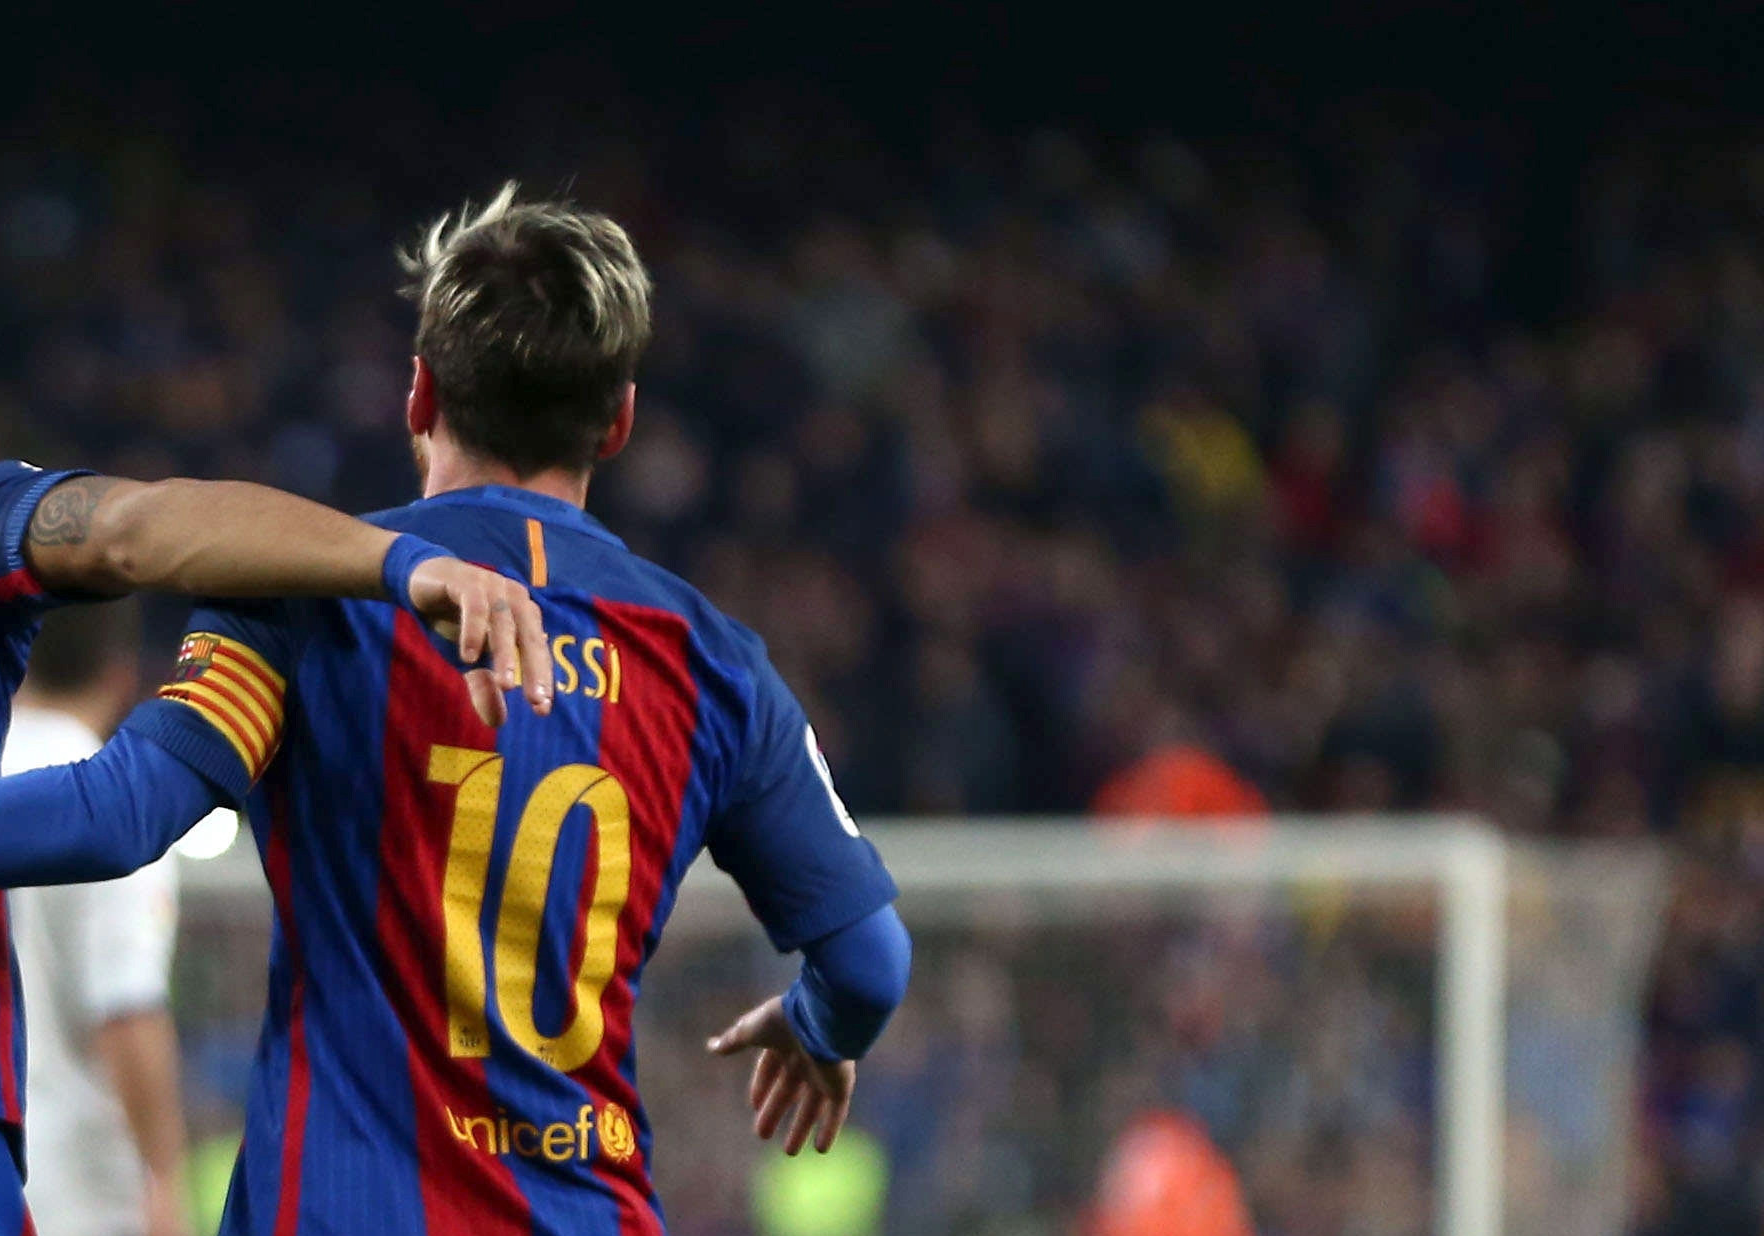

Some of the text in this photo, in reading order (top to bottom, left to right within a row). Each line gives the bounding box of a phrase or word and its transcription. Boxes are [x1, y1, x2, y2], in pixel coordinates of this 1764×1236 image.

[498, 633, 622, 704] SSI
[427, 745, 632, 1071] 10
[446, 1104, 593, 1161] unicef
